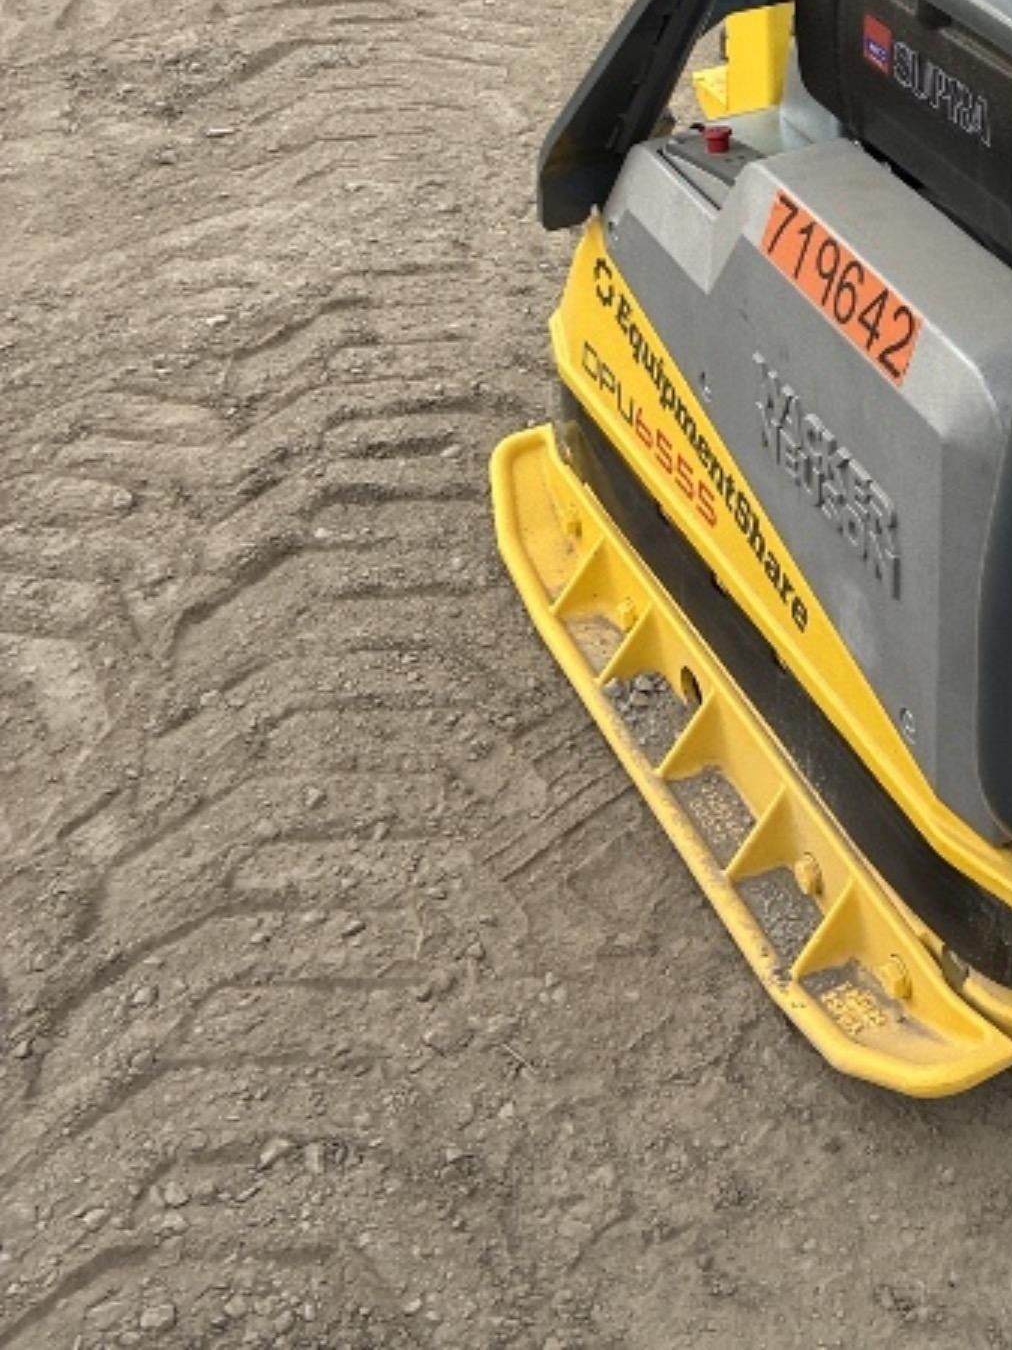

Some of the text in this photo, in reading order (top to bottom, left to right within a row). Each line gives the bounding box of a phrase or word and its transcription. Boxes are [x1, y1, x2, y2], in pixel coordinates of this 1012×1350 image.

[893, 40, 992, 148] SUPRA
[767, 195, 916, 379] 719642
[581, 340, 719, 529] DPU6555
[613, 293, 809, 634] EquipmentShare
[752, 351, 900, 556] WACKER
